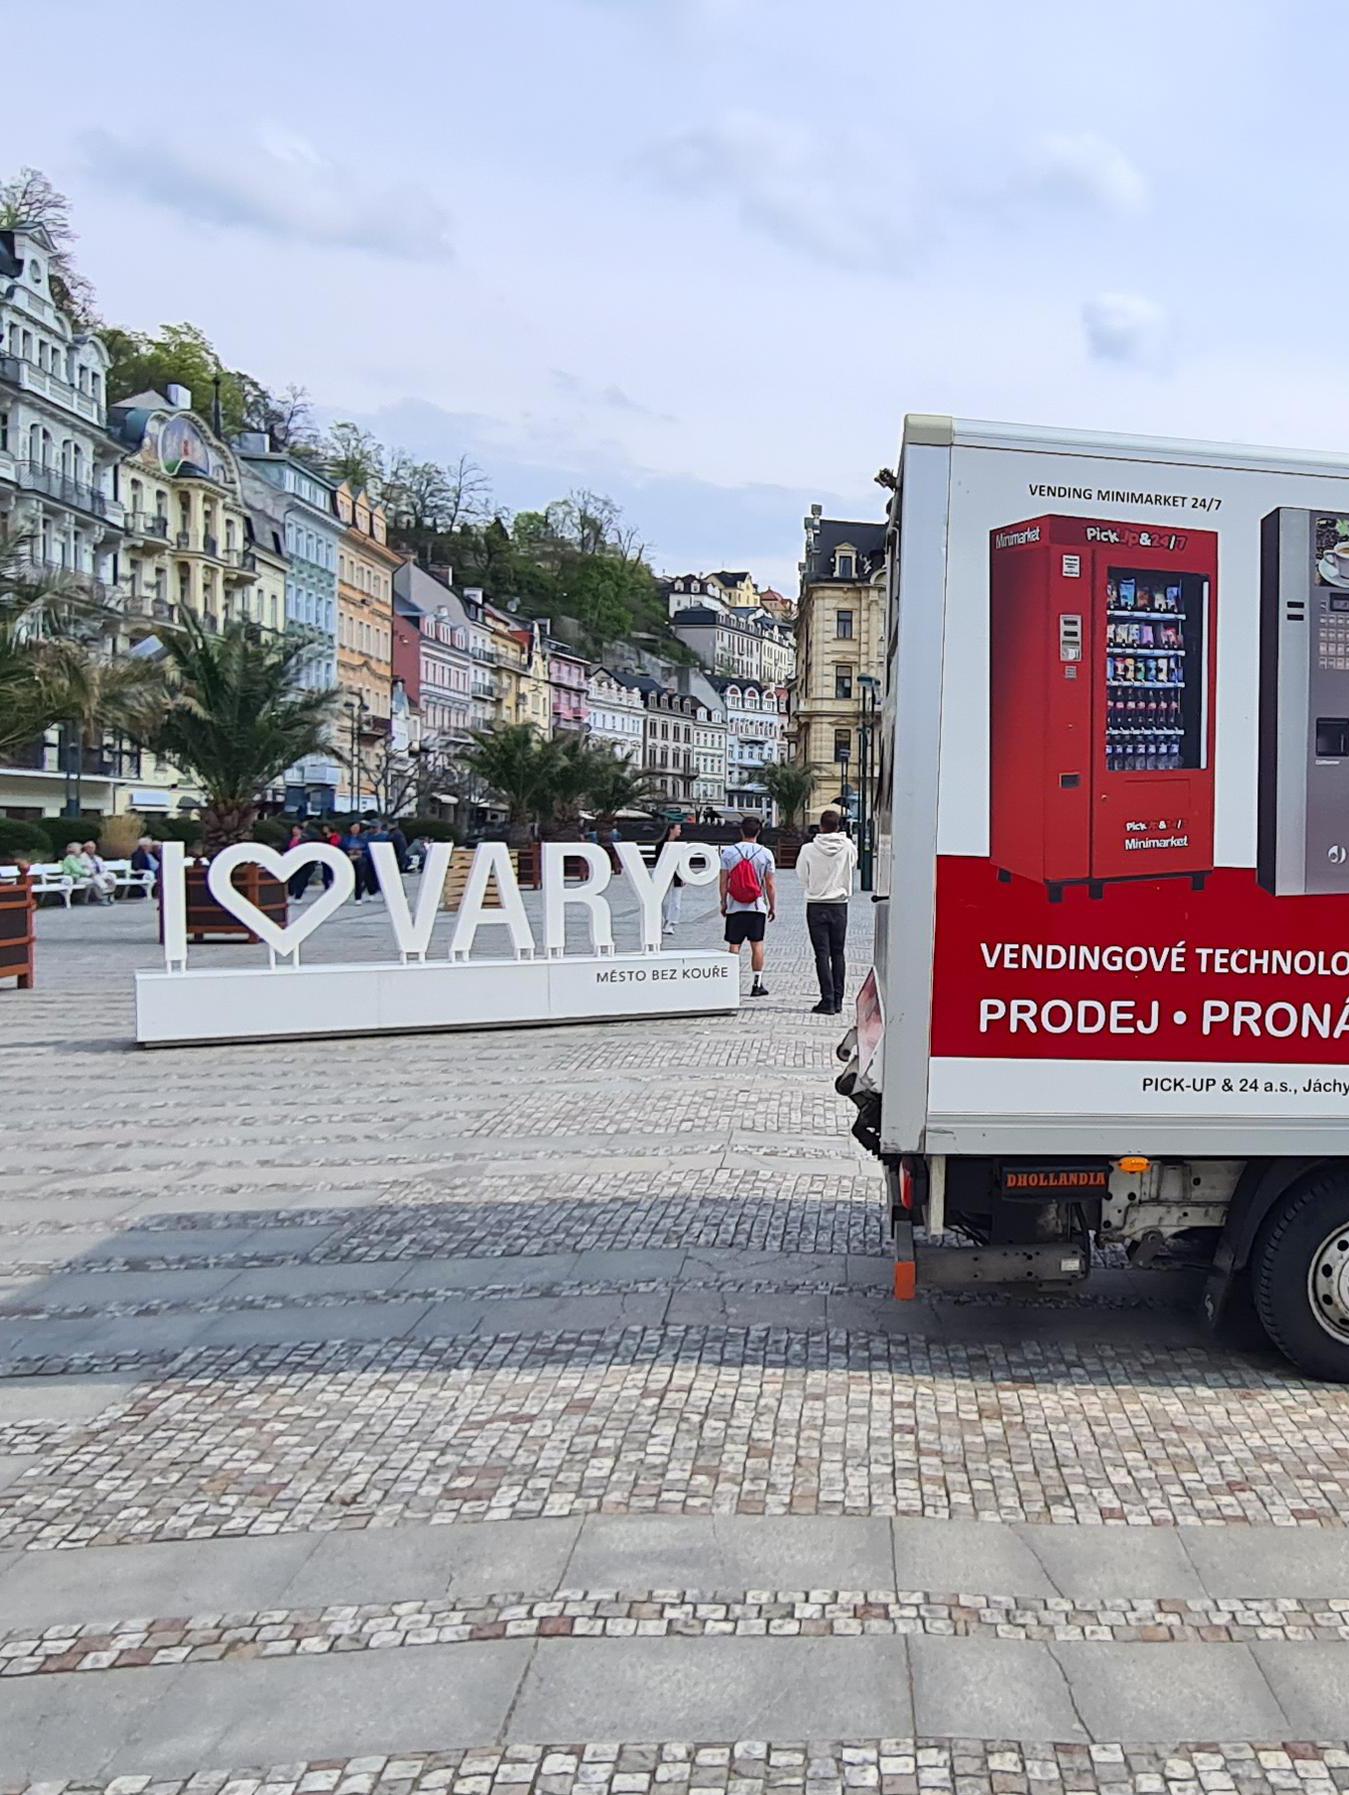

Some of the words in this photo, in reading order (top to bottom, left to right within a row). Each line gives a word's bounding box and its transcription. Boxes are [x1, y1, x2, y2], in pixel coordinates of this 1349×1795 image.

[1029, 484, 1093, 500] VENDING
[1097, 489, 1188, 507] MINIMARKET
[1191, 497, 1222, 512] 24/7
[995, 526, 1041, 549] Minimarket
[1125, 835, 1189, 850] Minimarket
[160, 841, 188, 961] I
[980, 940, 1187, 972] VENDINGOVÉ
[652, 968, 678, 981] BEZ
[682, 965, 729, 980] KOUŘE
[979, 998, 1160, 1035] PRODEJ
[1142, 1078, 1217, 1093] PICK-UP
[1221, 1078, 1234, 1093] &
[1239, 1078, 1260, 1093] 24
[1264, 1080, 1298, 1096] a.s.,
[1006, 1171, 1106, 1188] DHOLLANDIA
